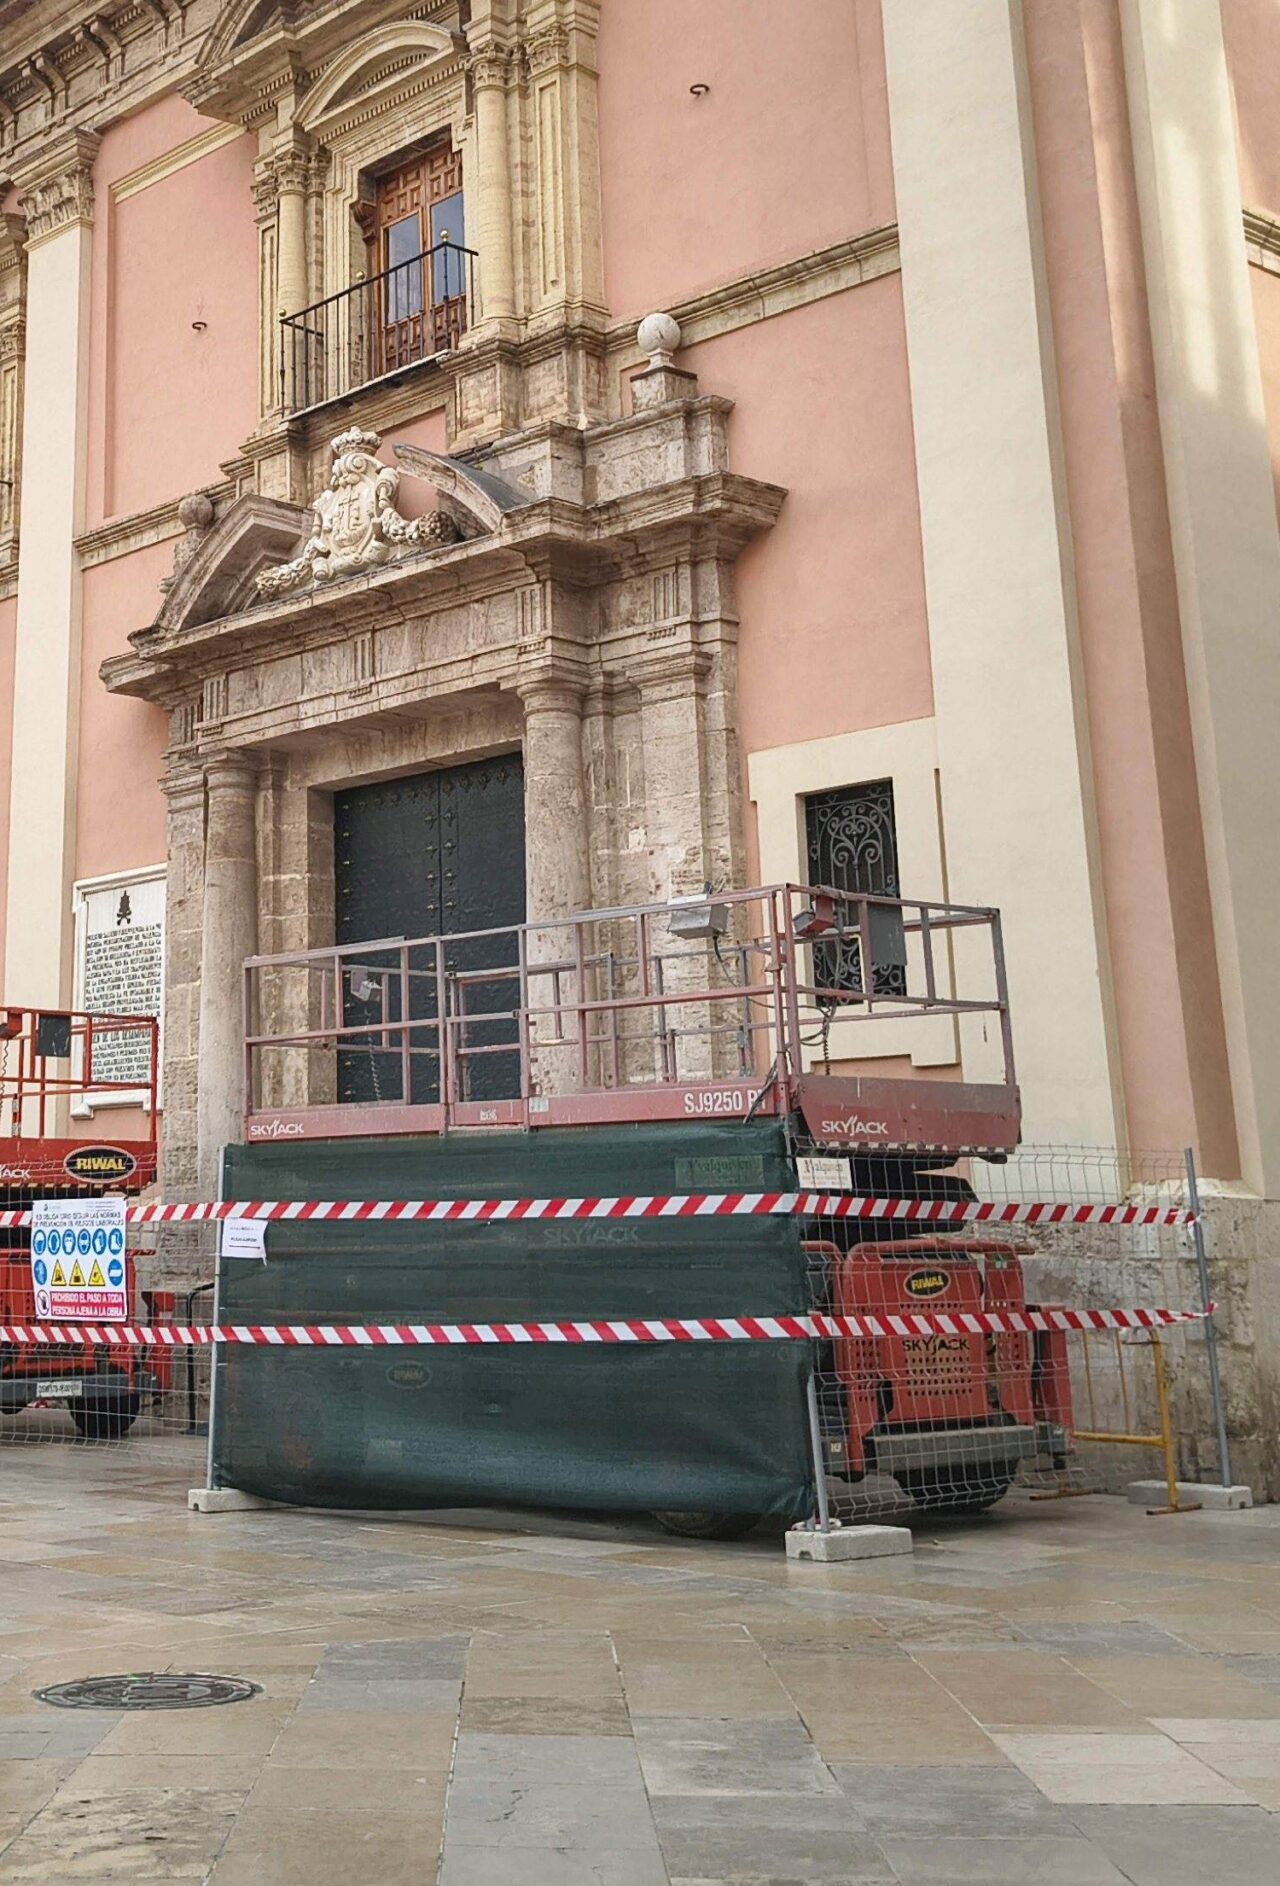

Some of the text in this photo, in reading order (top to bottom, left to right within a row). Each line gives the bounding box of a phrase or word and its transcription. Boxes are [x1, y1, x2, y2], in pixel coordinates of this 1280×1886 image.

[684, 1091, 743, 1114] SJ9250
[251, 1119, 304, 1137] SKYJACK
[822, 1115, 888, 1137] SKYJACK
[76, 1157, 126, 1170] RIWAL
[911, 1275, 944, 1291] RIWAL
[52, 1292, 79, 1302] PROHIBIDO
[80, 1292, 86, 1301] EL
[87, 1292, 101, 1302] PASO
[902, 1334, 970, 1355] SKYJACK
